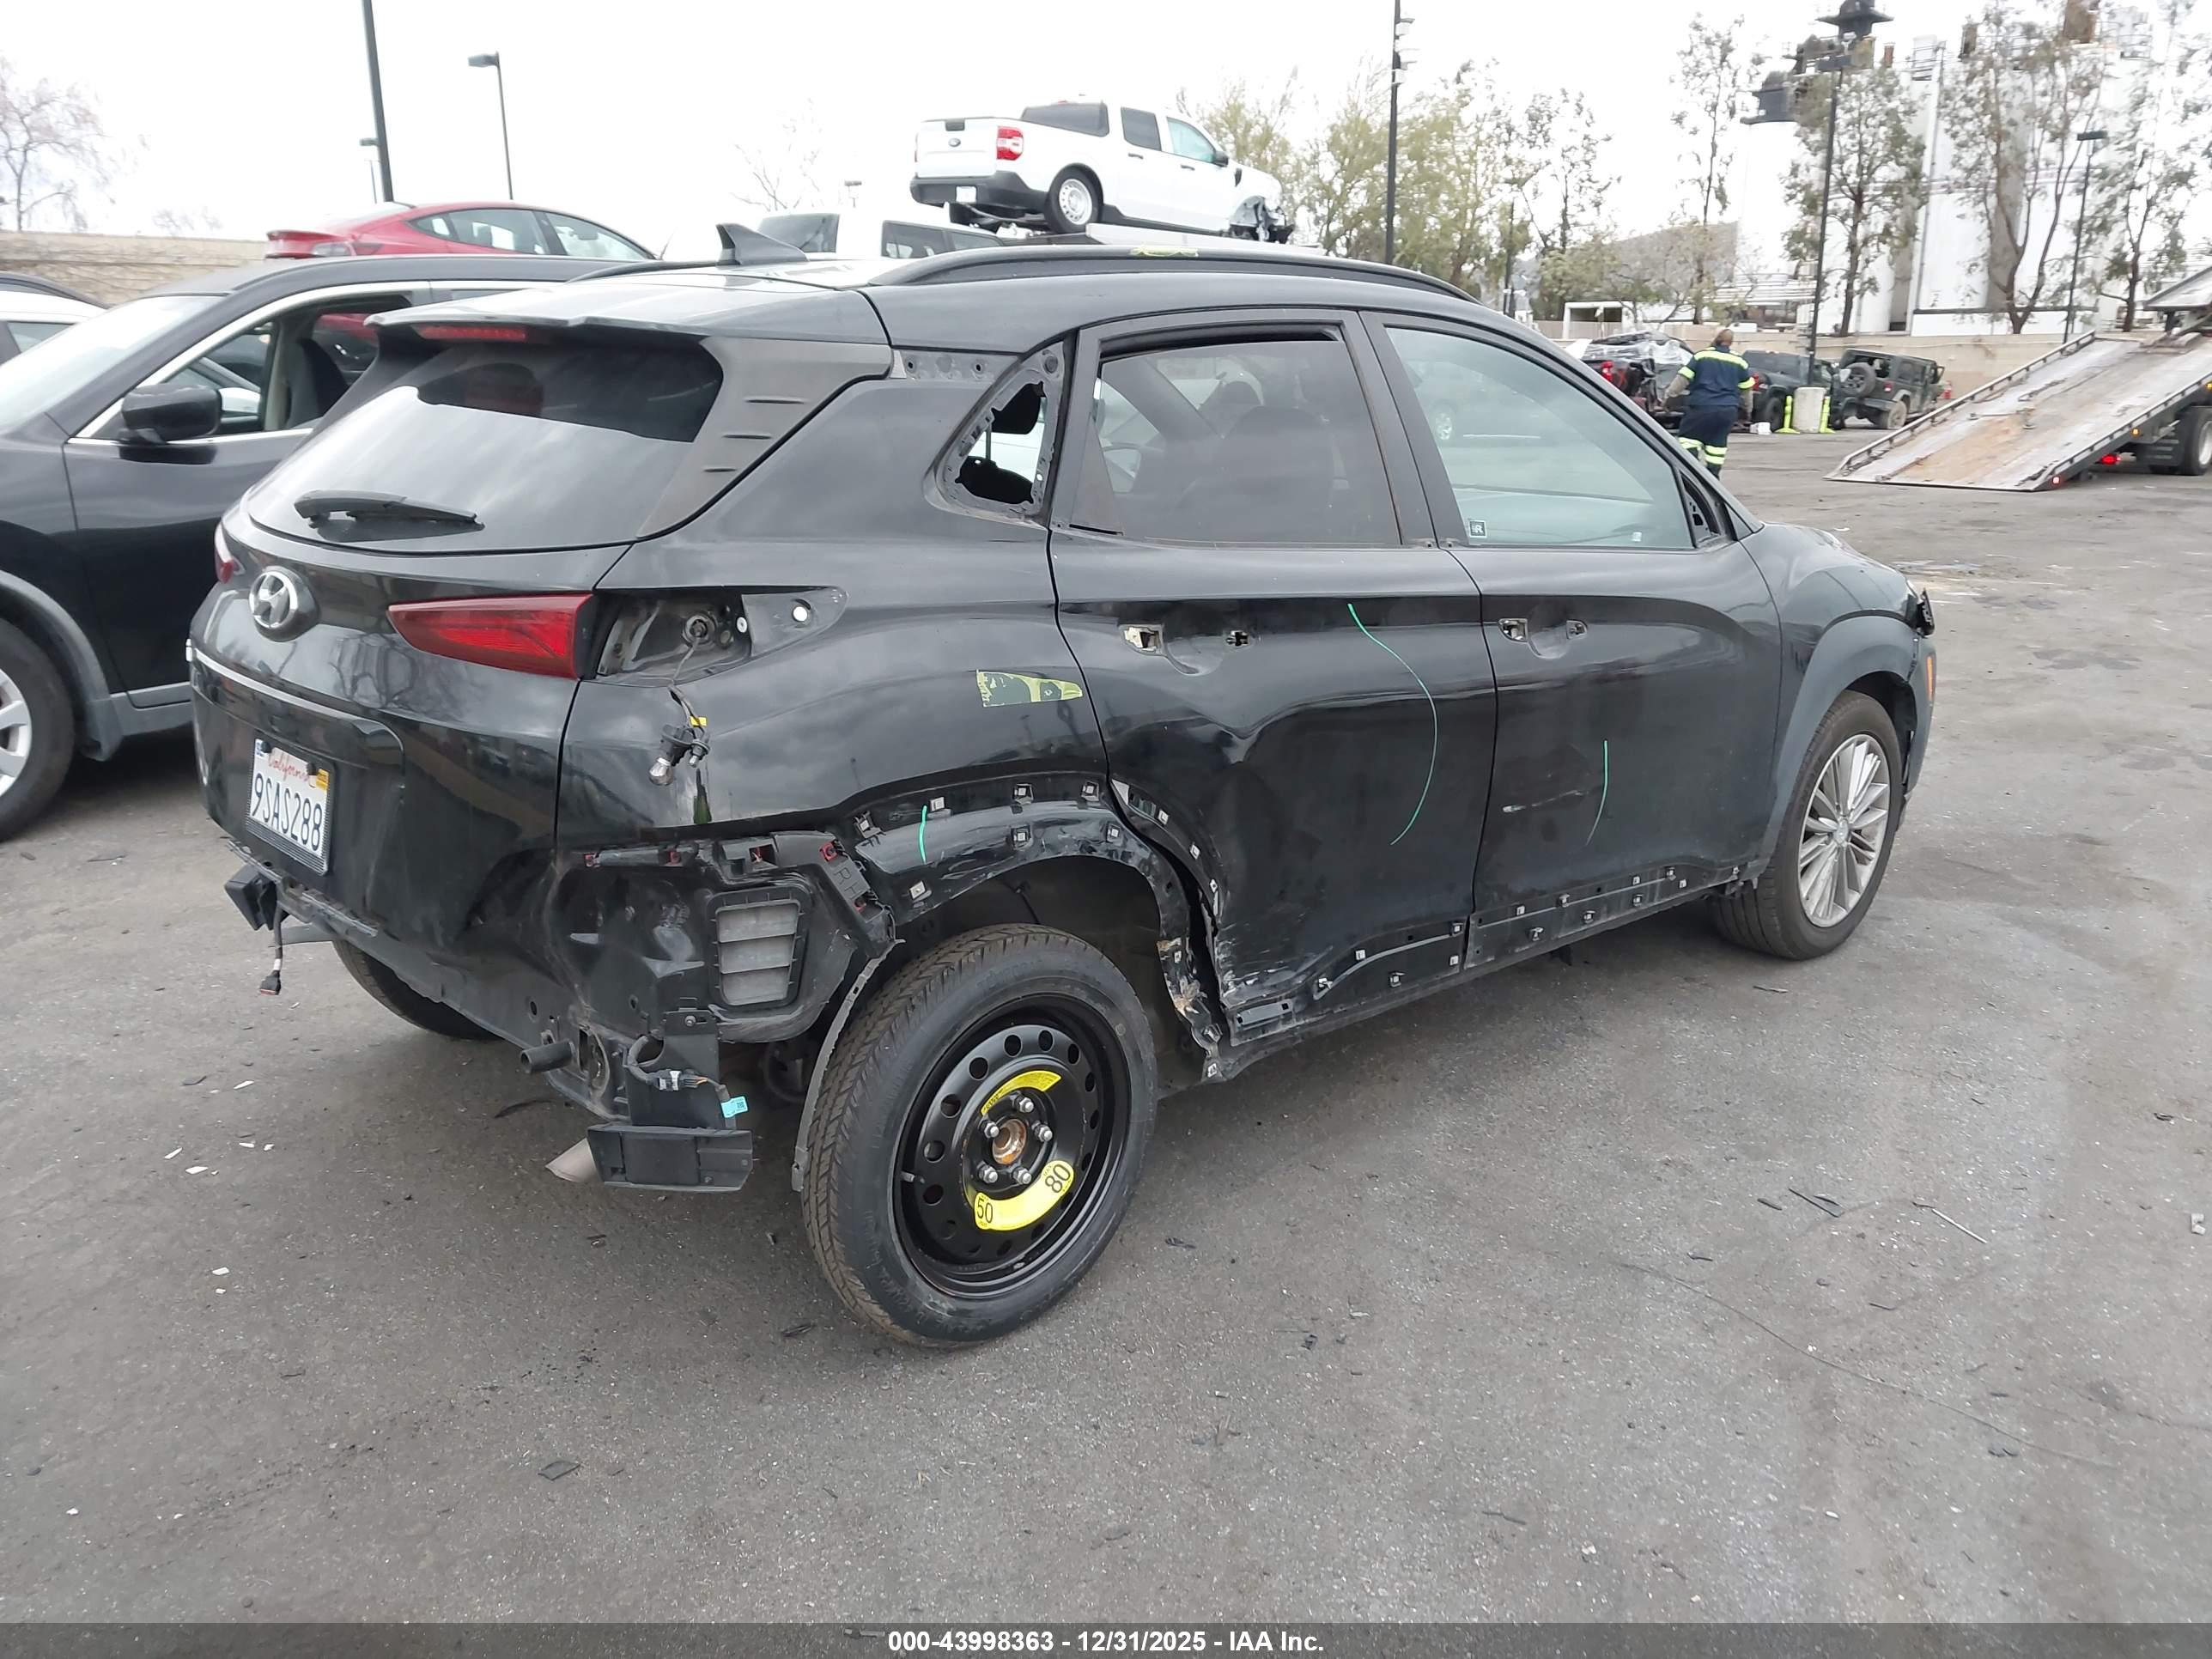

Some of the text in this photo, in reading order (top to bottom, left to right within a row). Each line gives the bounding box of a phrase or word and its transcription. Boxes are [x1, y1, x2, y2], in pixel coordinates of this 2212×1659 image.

[252, 774, 322, 851] 9SAS288
[1045, 1164, 1070, 1193] 80
[976, 1198, 994, 1224] 50
